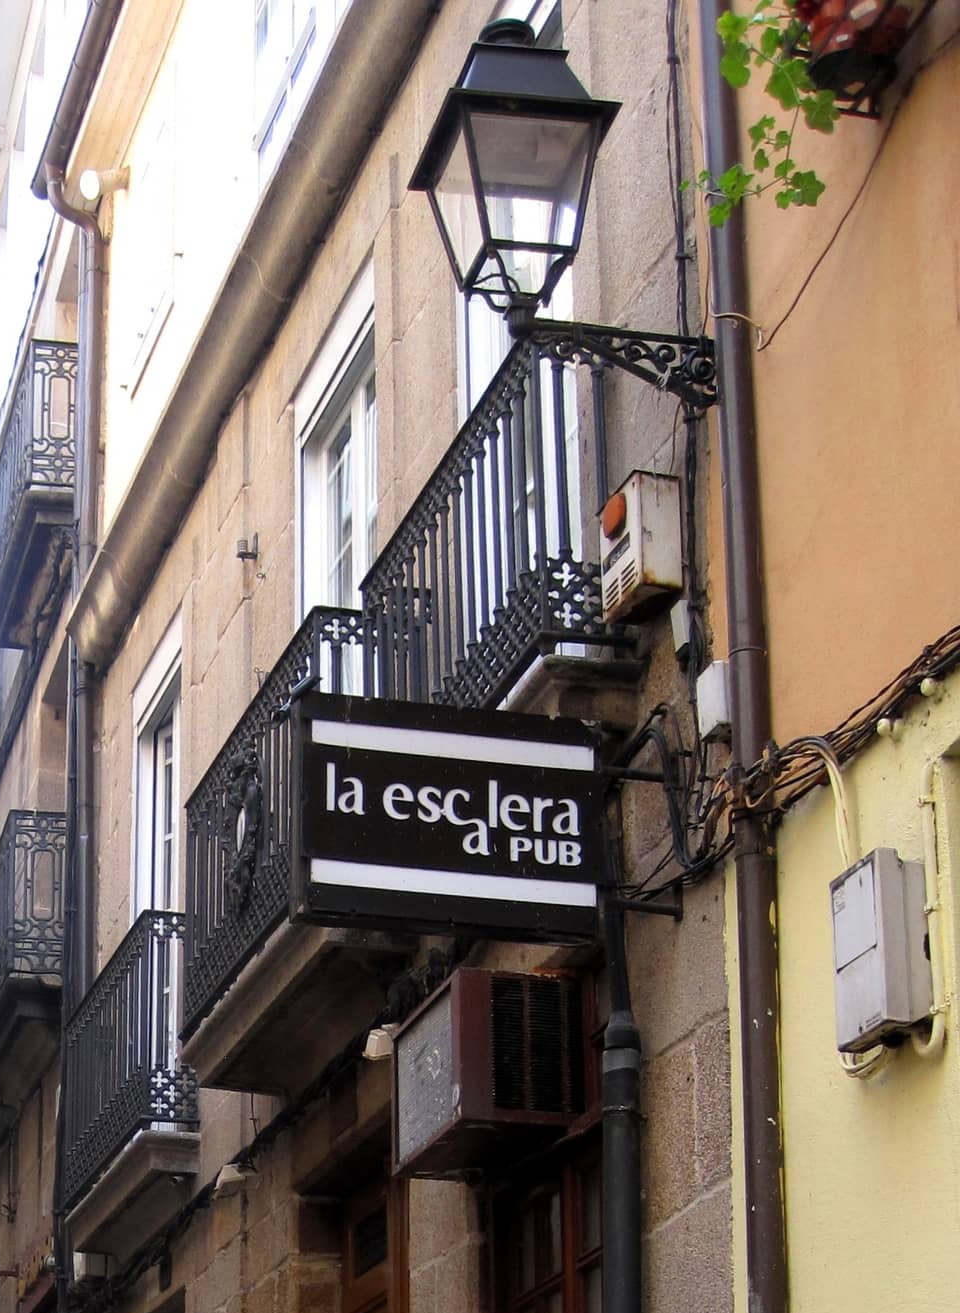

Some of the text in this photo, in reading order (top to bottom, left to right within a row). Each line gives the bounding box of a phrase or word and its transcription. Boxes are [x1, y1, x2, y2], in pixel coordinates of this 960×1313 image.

[326, 762, 581, 856] la escalera
[509, 836, 582, 866] PUB
